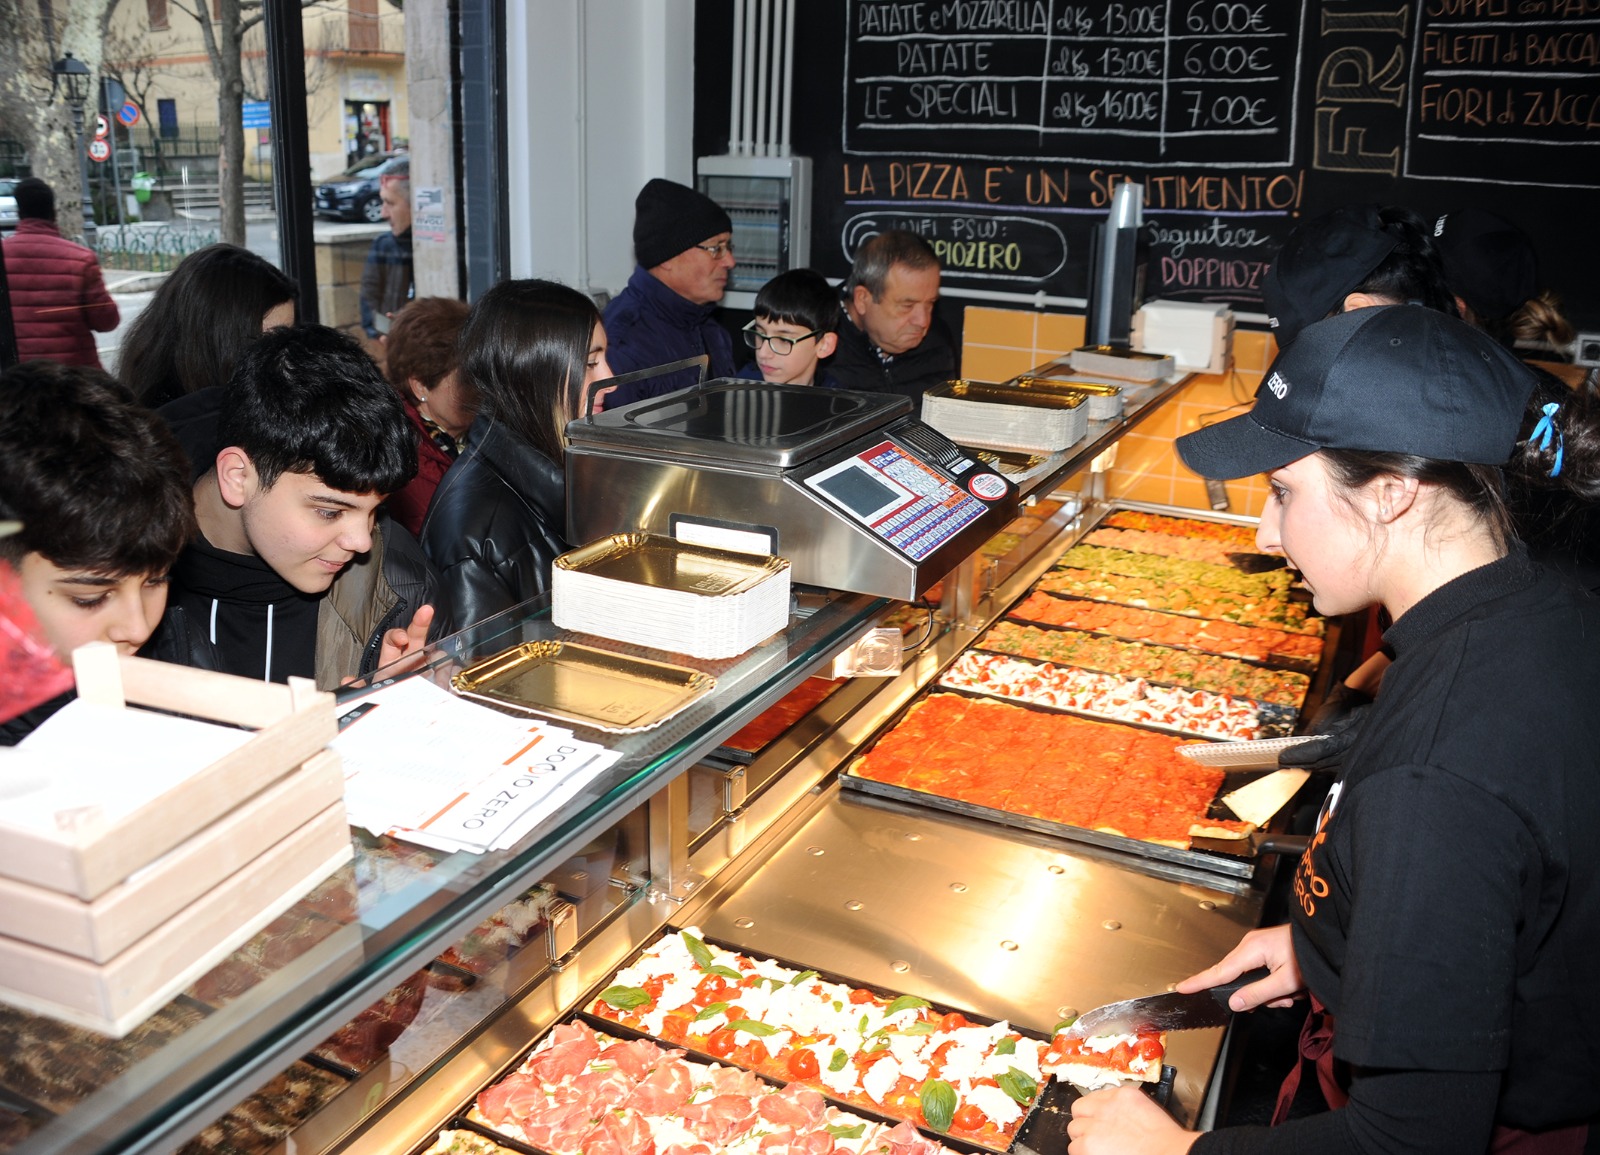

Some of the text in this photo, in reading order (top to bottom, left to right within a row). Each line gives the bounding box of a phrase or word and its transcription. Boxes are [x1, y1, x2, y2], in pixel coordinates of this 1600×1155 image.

[859, 0, 1047, 33] PATATE e MOZZARELLA
[1187, 2, 1272, 33] 6,00€
[898, 41, 994, 74] PATATE
[1184, 43, 1273, 76] 6,00€
[1423, 31, 1500, 64] FILETTI
[865, 82, 1017, 119] LE SPECIALI
[1182, 90, 1277, 128] 7,00€
[1421, 84, 1493, 127] FIORI
[843, 163, 875, 195] LA
[890, 162, 969, 200] PIZZA
[1026, 167, 1069, 205] UN
[927, 239, 1022, 271] PIOZERO
[1267, 371, 1288, 400] ZERO
[462, 790, 519, 830] ZERO
